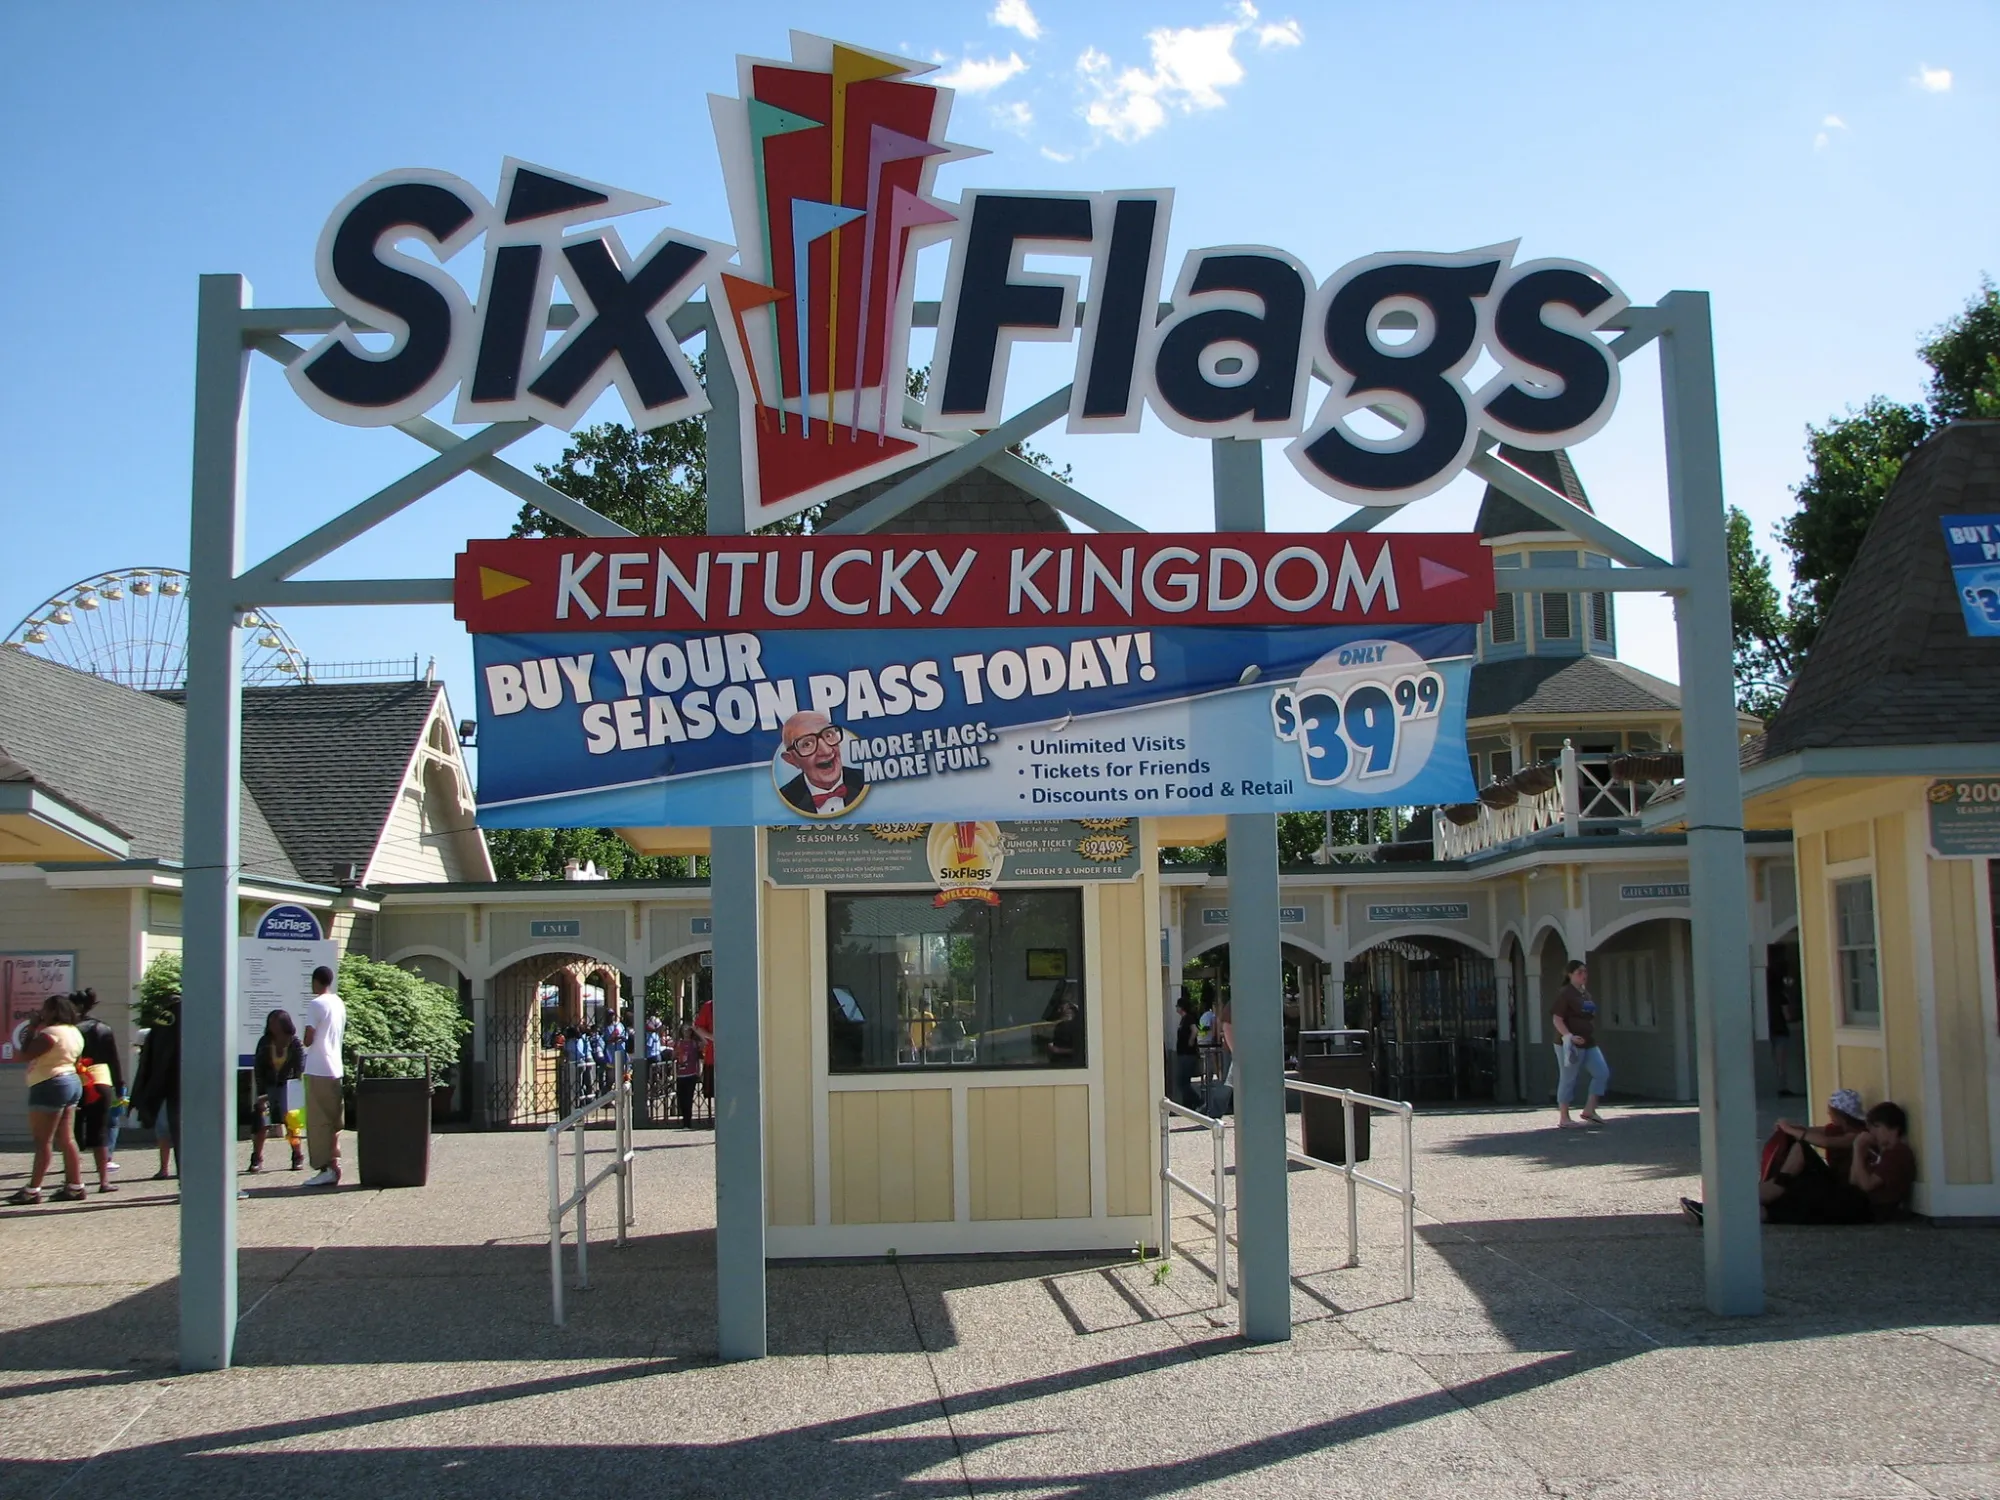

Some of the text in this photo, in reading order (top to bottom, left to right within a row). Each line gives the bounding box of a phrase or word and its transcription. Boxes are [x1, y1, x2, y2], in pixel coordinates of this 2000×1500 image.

[292, 158, 1624, 500] Six Flags
[1948, 525, 1991, 544] BUY
[555, 539, 1400, 622] KENTUCKY KINGDOM
[1338, 645, 1388, 666] ONLY
[485, 632, 766, 716] BUY YOUR
[582, 632, 1156, 754] SEASON PASS TODAY!
[851, 722, 997, 761] MORE FLAGS.
[1030, 736, 1186, 755] Unlimited Visits
[863, 746, 988, 782] MORE FUN.
[1031, 759, 1211, 780] Tickets for Friends
[1032, 779, 1294, 804] Discounts on Food & Retail
[796, 834, 860, 843] SEASON PASS
[1007, 839, 1072, 848] JUNIOR TICKET
[1085, 840, 1123, 855] $24.99
[940, 867, 992, 880] SixFlags
[1015, 868, 1056, 876] CHILDREN
[1073, 867, 1100, 875] UNDER
[1103, 866, 1122, 874] FREE
[940, 888, 994, 901] WELCOME
[267, 919, 312, 932] SixFlags
[543, 924, 568, 933] EXIT
